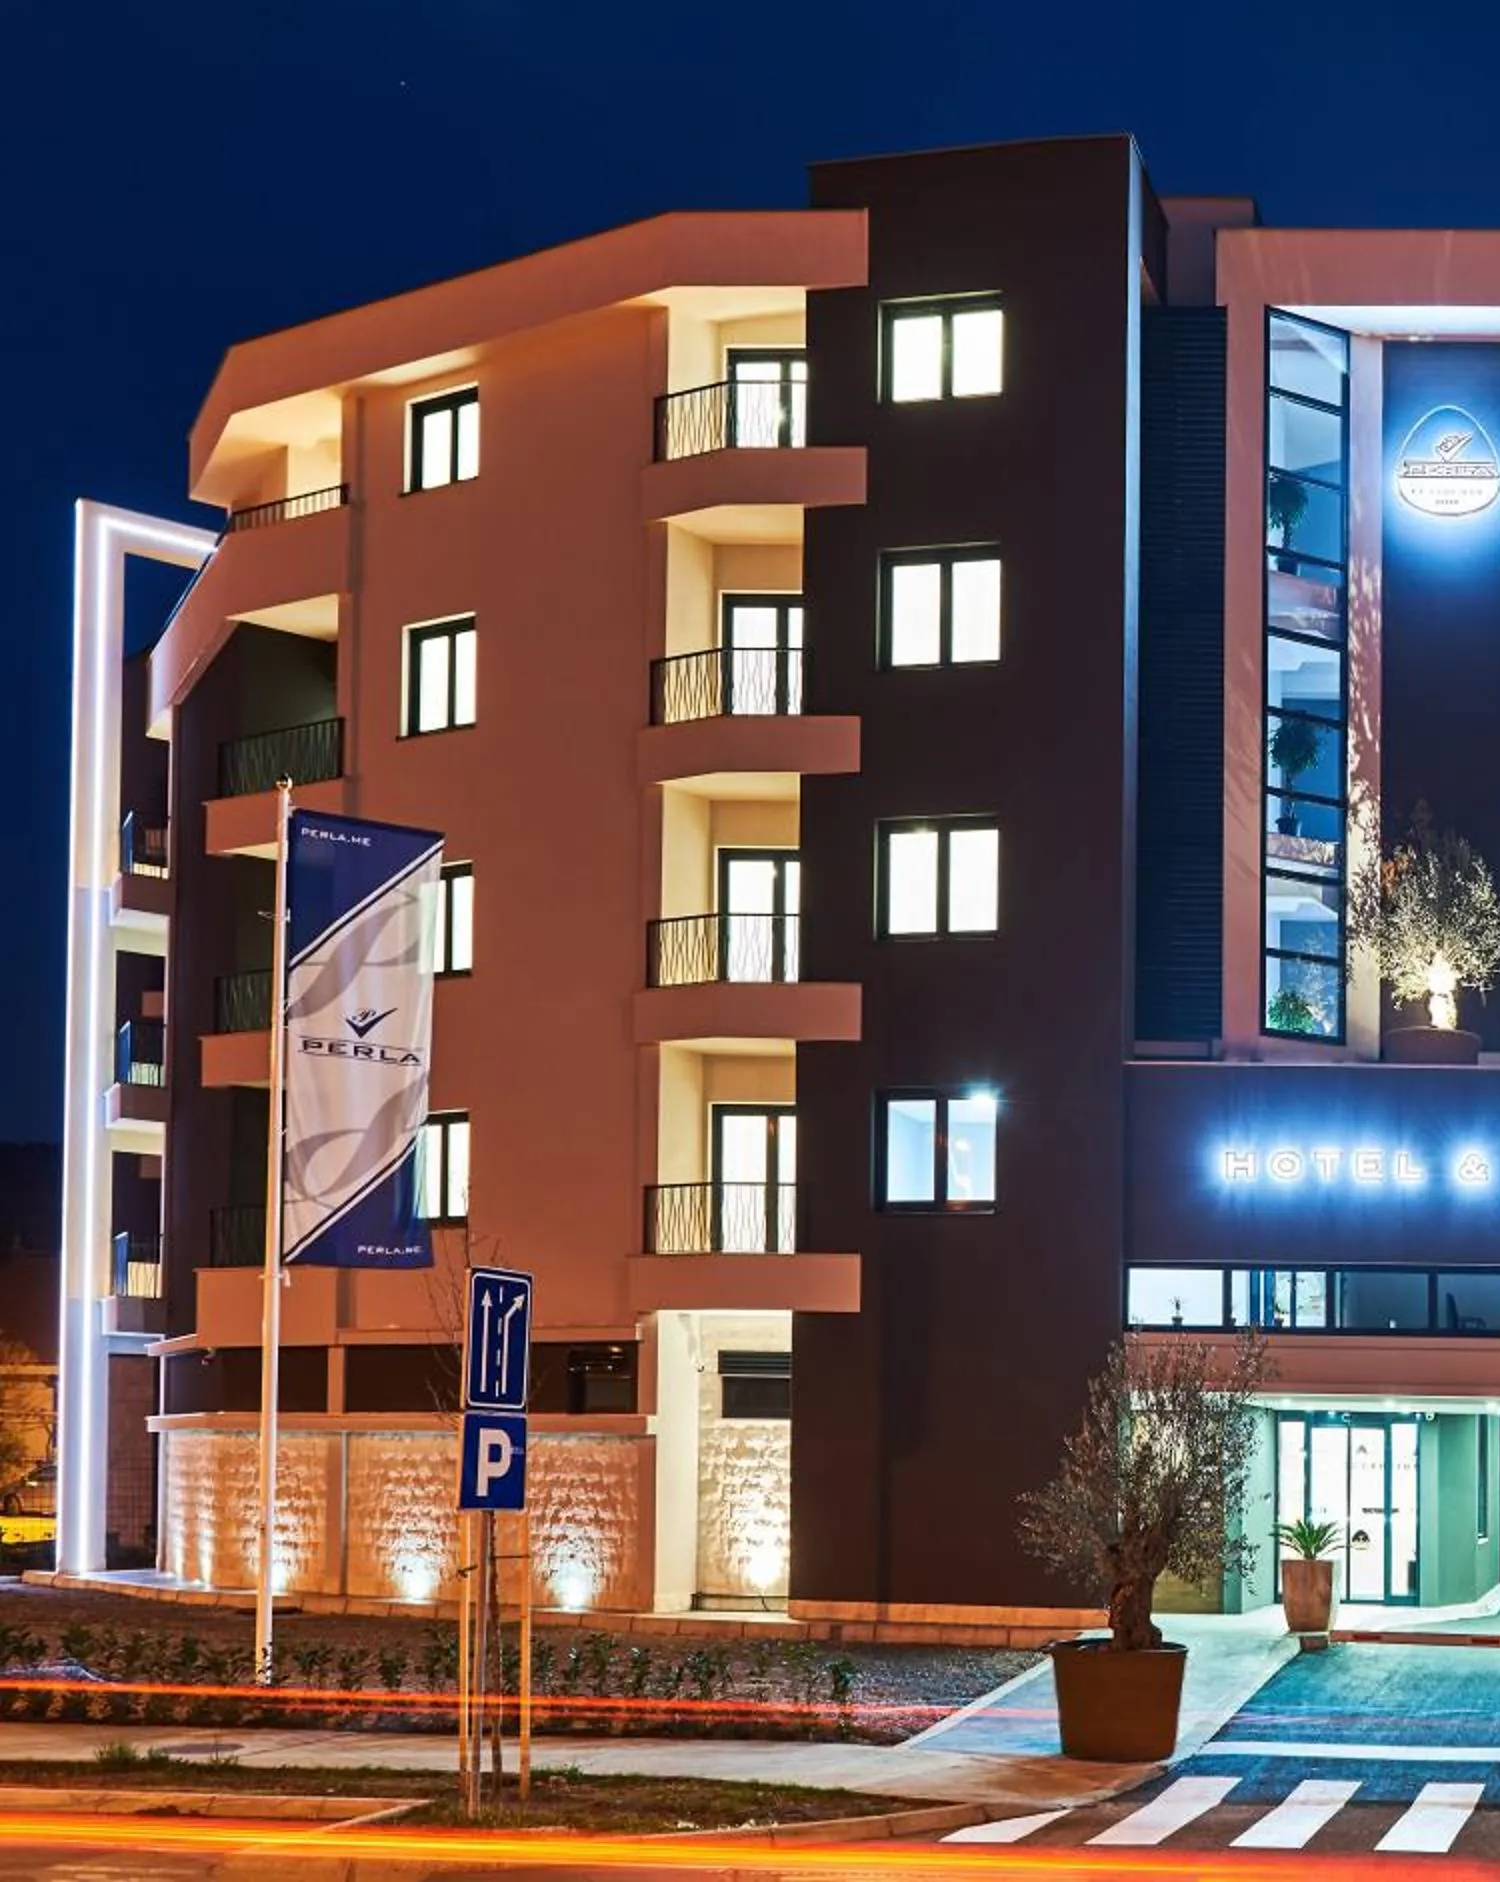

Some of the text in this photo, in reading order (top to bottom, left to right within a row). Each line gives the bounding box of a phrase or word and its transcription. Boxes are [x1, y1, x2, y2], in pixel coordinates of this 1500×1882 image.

[301, 827, 372, 847] PERLA.ME
[303, 1040, 420, 1063] PERLA
[1225, 1151, 1421, 1182] HOTEL
[1458, 1153, 1490, 1182] &
[476, 1427, 512, 1497] P
